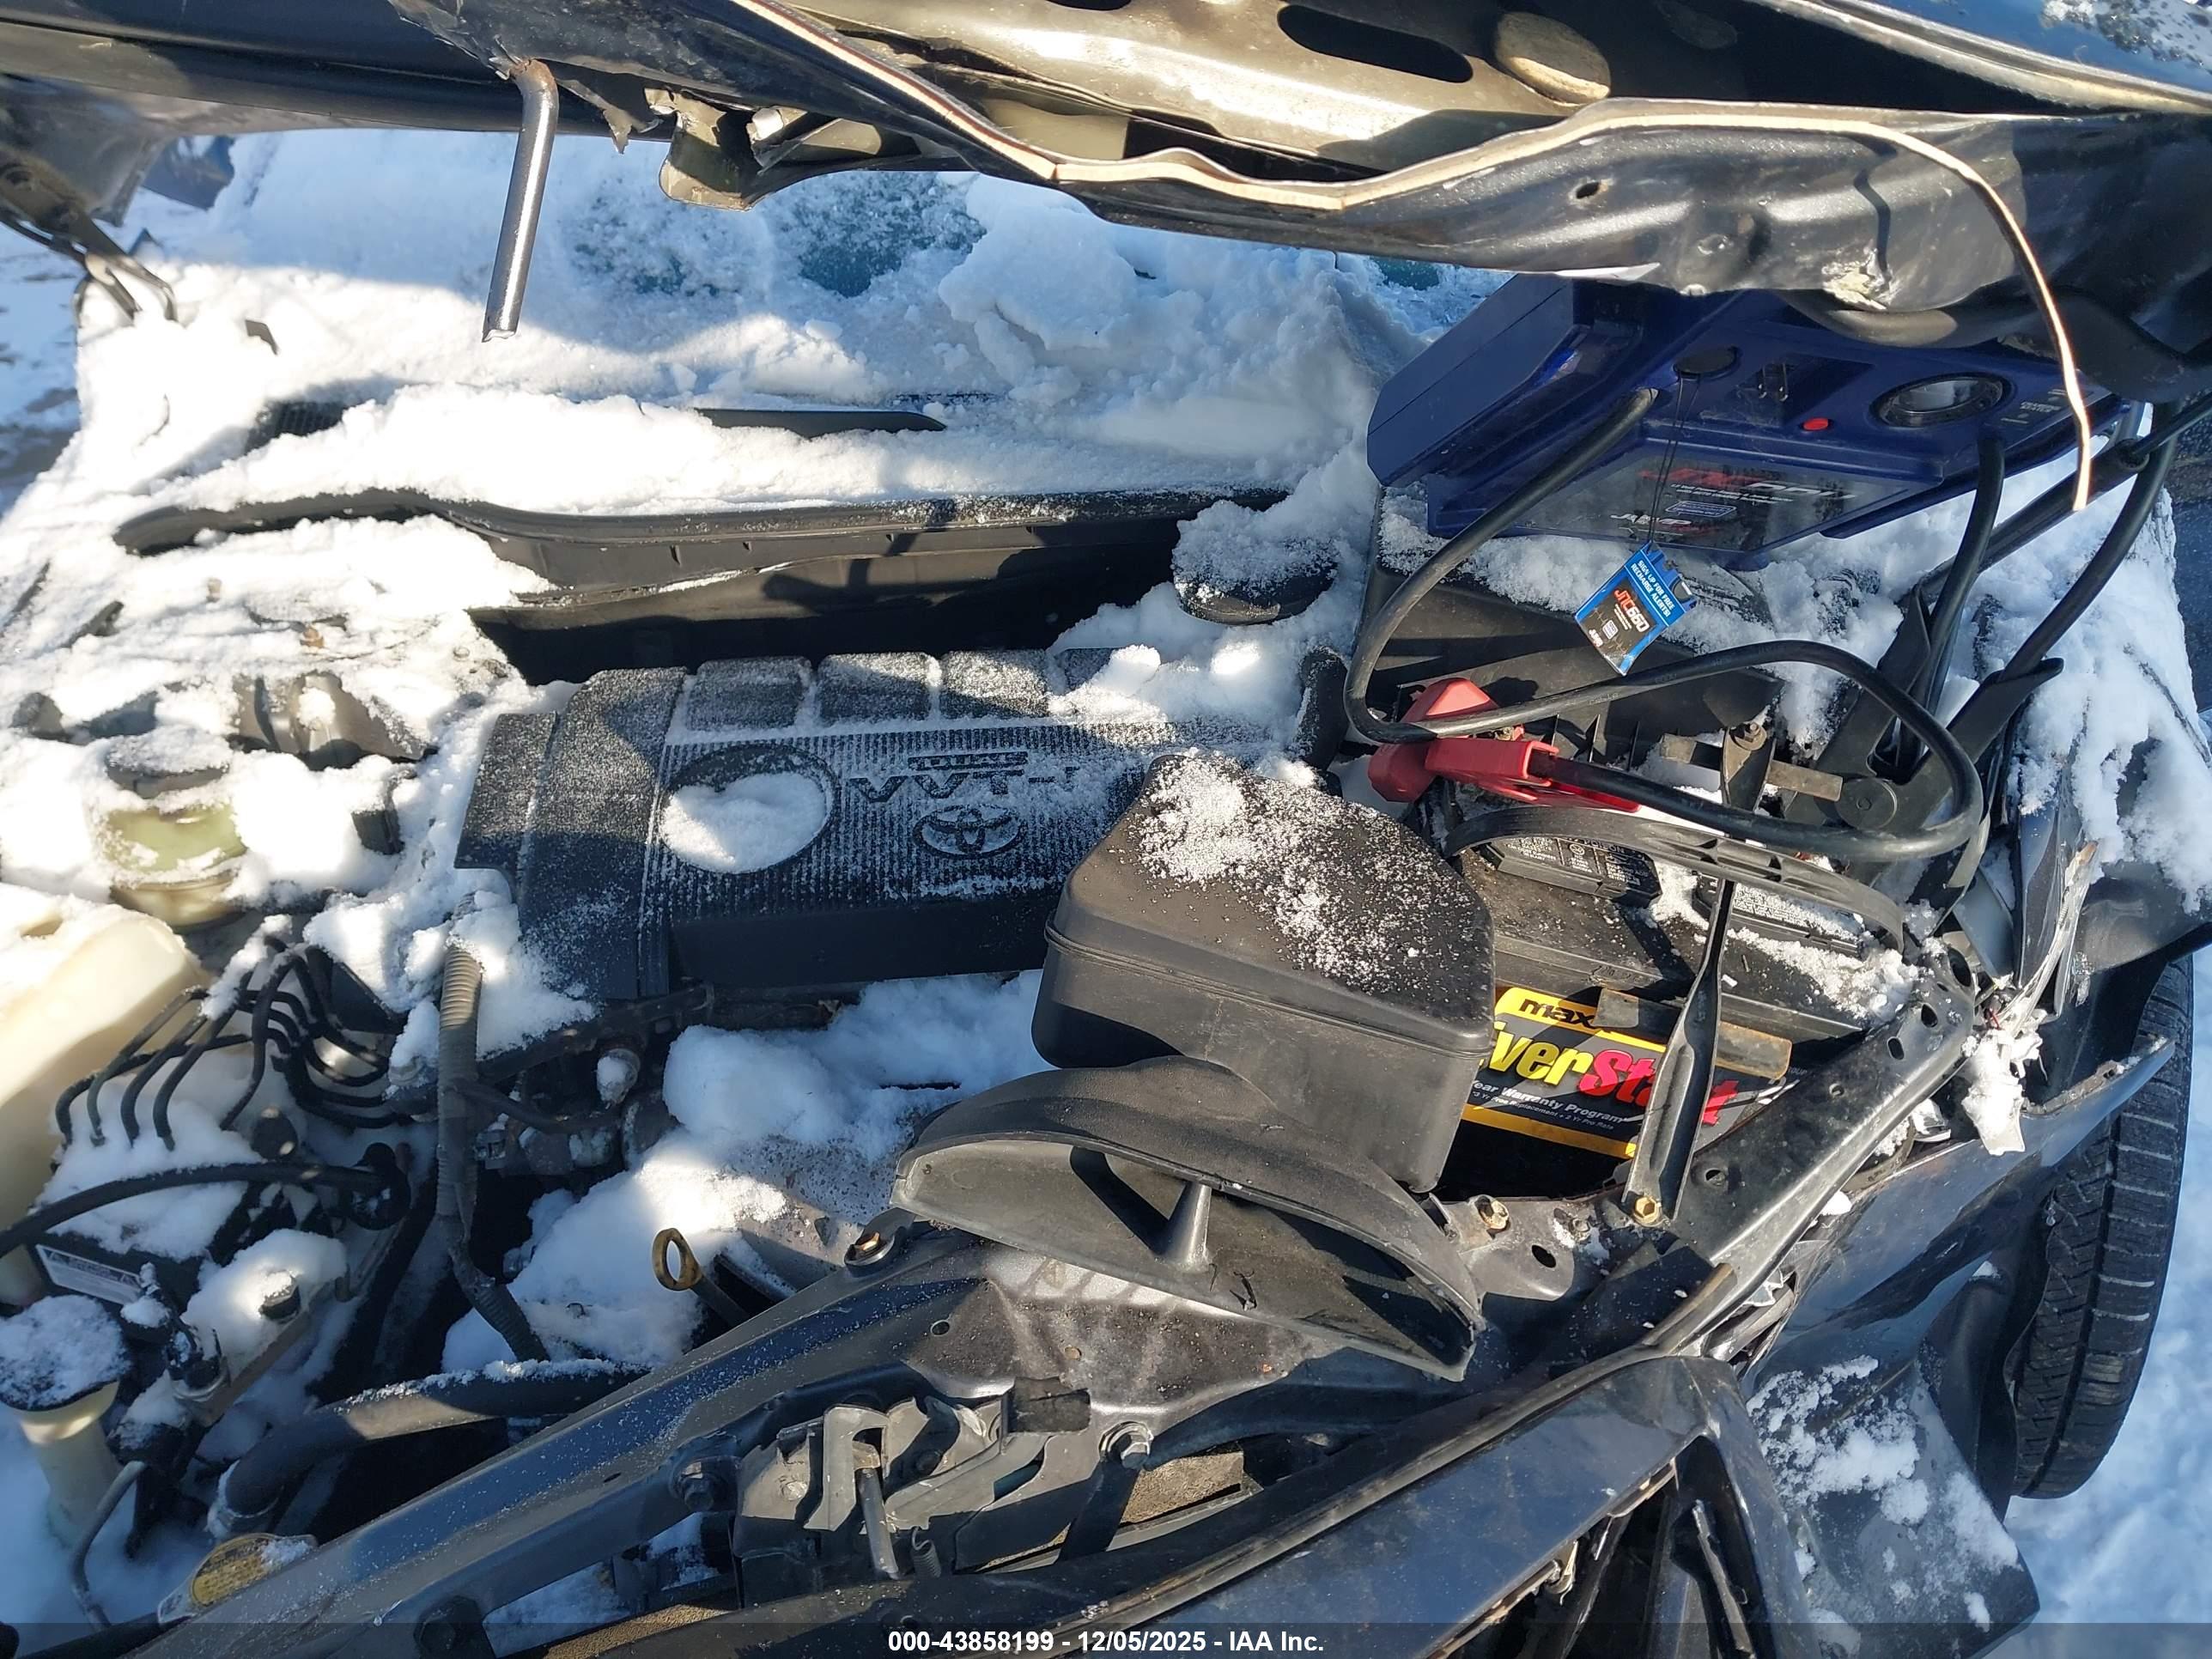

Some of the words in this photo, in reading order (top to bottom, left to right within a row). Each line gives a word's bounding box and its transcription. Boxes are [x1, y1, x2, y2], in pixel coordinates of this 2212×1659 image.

[1631, 563, 1654, 593] RECHARGE
[1638, 560, 1650, 577] SIGN
[1646, 574, 1656, 583] UP
[1653, 582, 1664, 595] FOR
[1662, 592, 1675, 611] FREE
[1583, 839, 1625, 854] POISON
[1473, 1079, 1499, 1093] ear
[1500, 1087, 1564, 1109] Warranty
[1491, 1095, 1510, 1104] Free
[1509, 1100, 1559, 1118] Replacement
